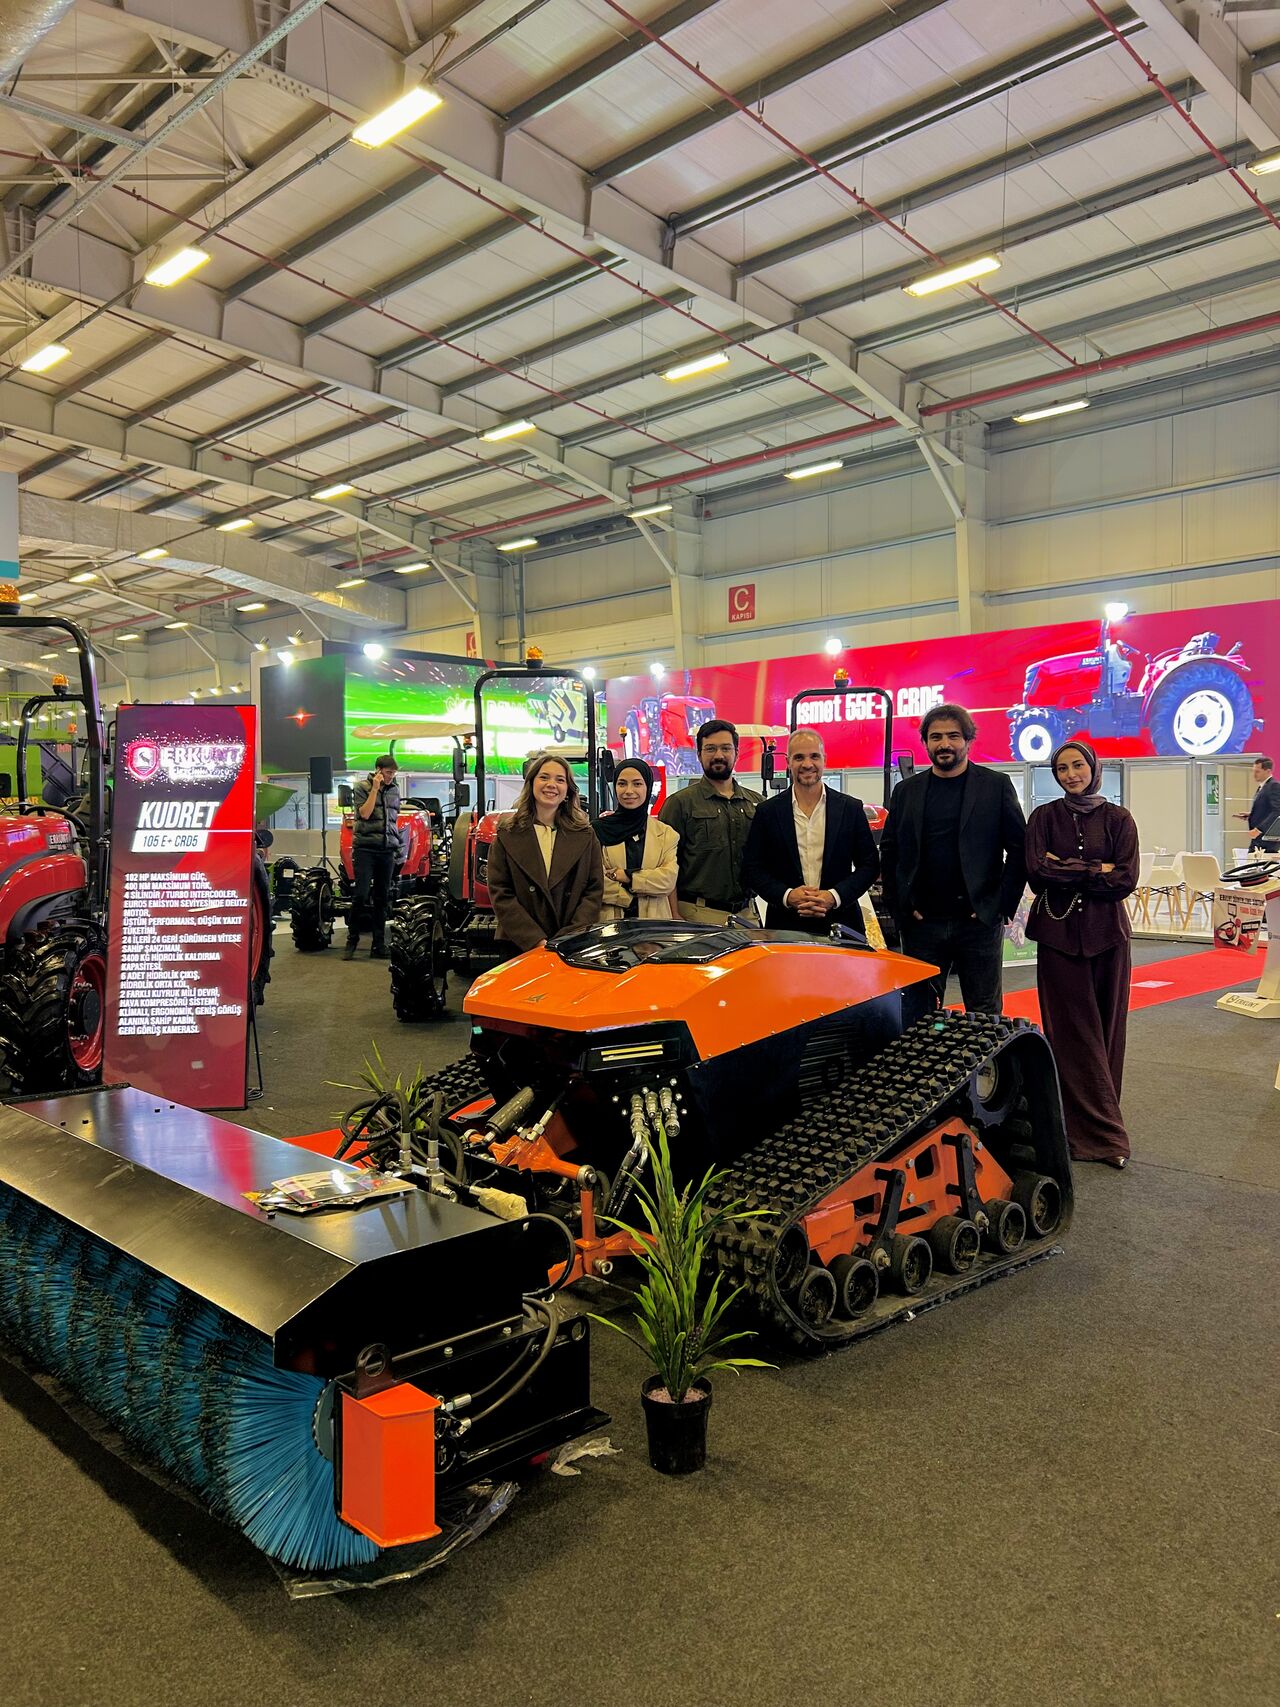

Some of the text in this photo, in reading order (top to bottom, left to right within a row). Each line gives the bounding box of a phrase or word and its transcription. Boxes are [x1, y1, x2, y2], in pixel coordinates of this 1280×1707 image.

[734, 588, 749, 611] C
[137, 801, 220, 829] KUDRET
[143, 835, 159, 848] 105
[174, 834, 199, 848] CRD5
[139, 873, 150, 881] HP
[150, 872, 190, 881] MAKSİMUM
[152, 880, 190, 890] MAKSİMUM
[192, 881, 212, 890] TORK,
[124, 891, 130, 899] 4
[130, 890, 160, 899] SİLİNDİR
[166, 890, 189, 899] TURBO
[124, 898, 248, 908] EURO5 EMİSYON SEVİYESİNDE DEUTZ
[124, 908, 150, 918] MOTOR,
[124, 915, 242, 926] ÜSTÜN PERFORMANS, DÜŞÜK YAKIT
[122, 936, 132, 944] 24
[151, 935, 160, 944] 24
[161, 934, 178, 943] GERİ
[179, 933, 216, 943] SÜRÜNGEN
[218, 932, 242, 942] VİTESE
[122, 943, 144, 953] SAHİP
[140, 953, 150, 962] KG
[151, 952, 184, 961] HİDROLİK
[184, 952, 220, 960] KALDIRMA
[127, 971, 146, 980] ADET
[146, 970, 180, 980] HİDROLİK
[120, 980, 154, 989] HİDROLİK
[154, 980, 174, 989] ORTA
[120, 990, 126, 998] 2
[126, 990, 150, 998] FARKLI
[151, 989, 180, 998] KUYRUK
[120, 998, 140, 1008] HAVA
[140, 997, 188, 1007] KOMPRESÖRÜ
[195, 1005, 216, 1016] GENİŞ
[217, 1004, 242, 1016] GÖRÜŞ
[118, 1017, 150, 1026] ALANINA
[150, 1016, 172, 1025] SAHİP
[118, 1026, 136, 1035] GERİ
[136, 1025, 161, 1036] GÖRÜŞ
